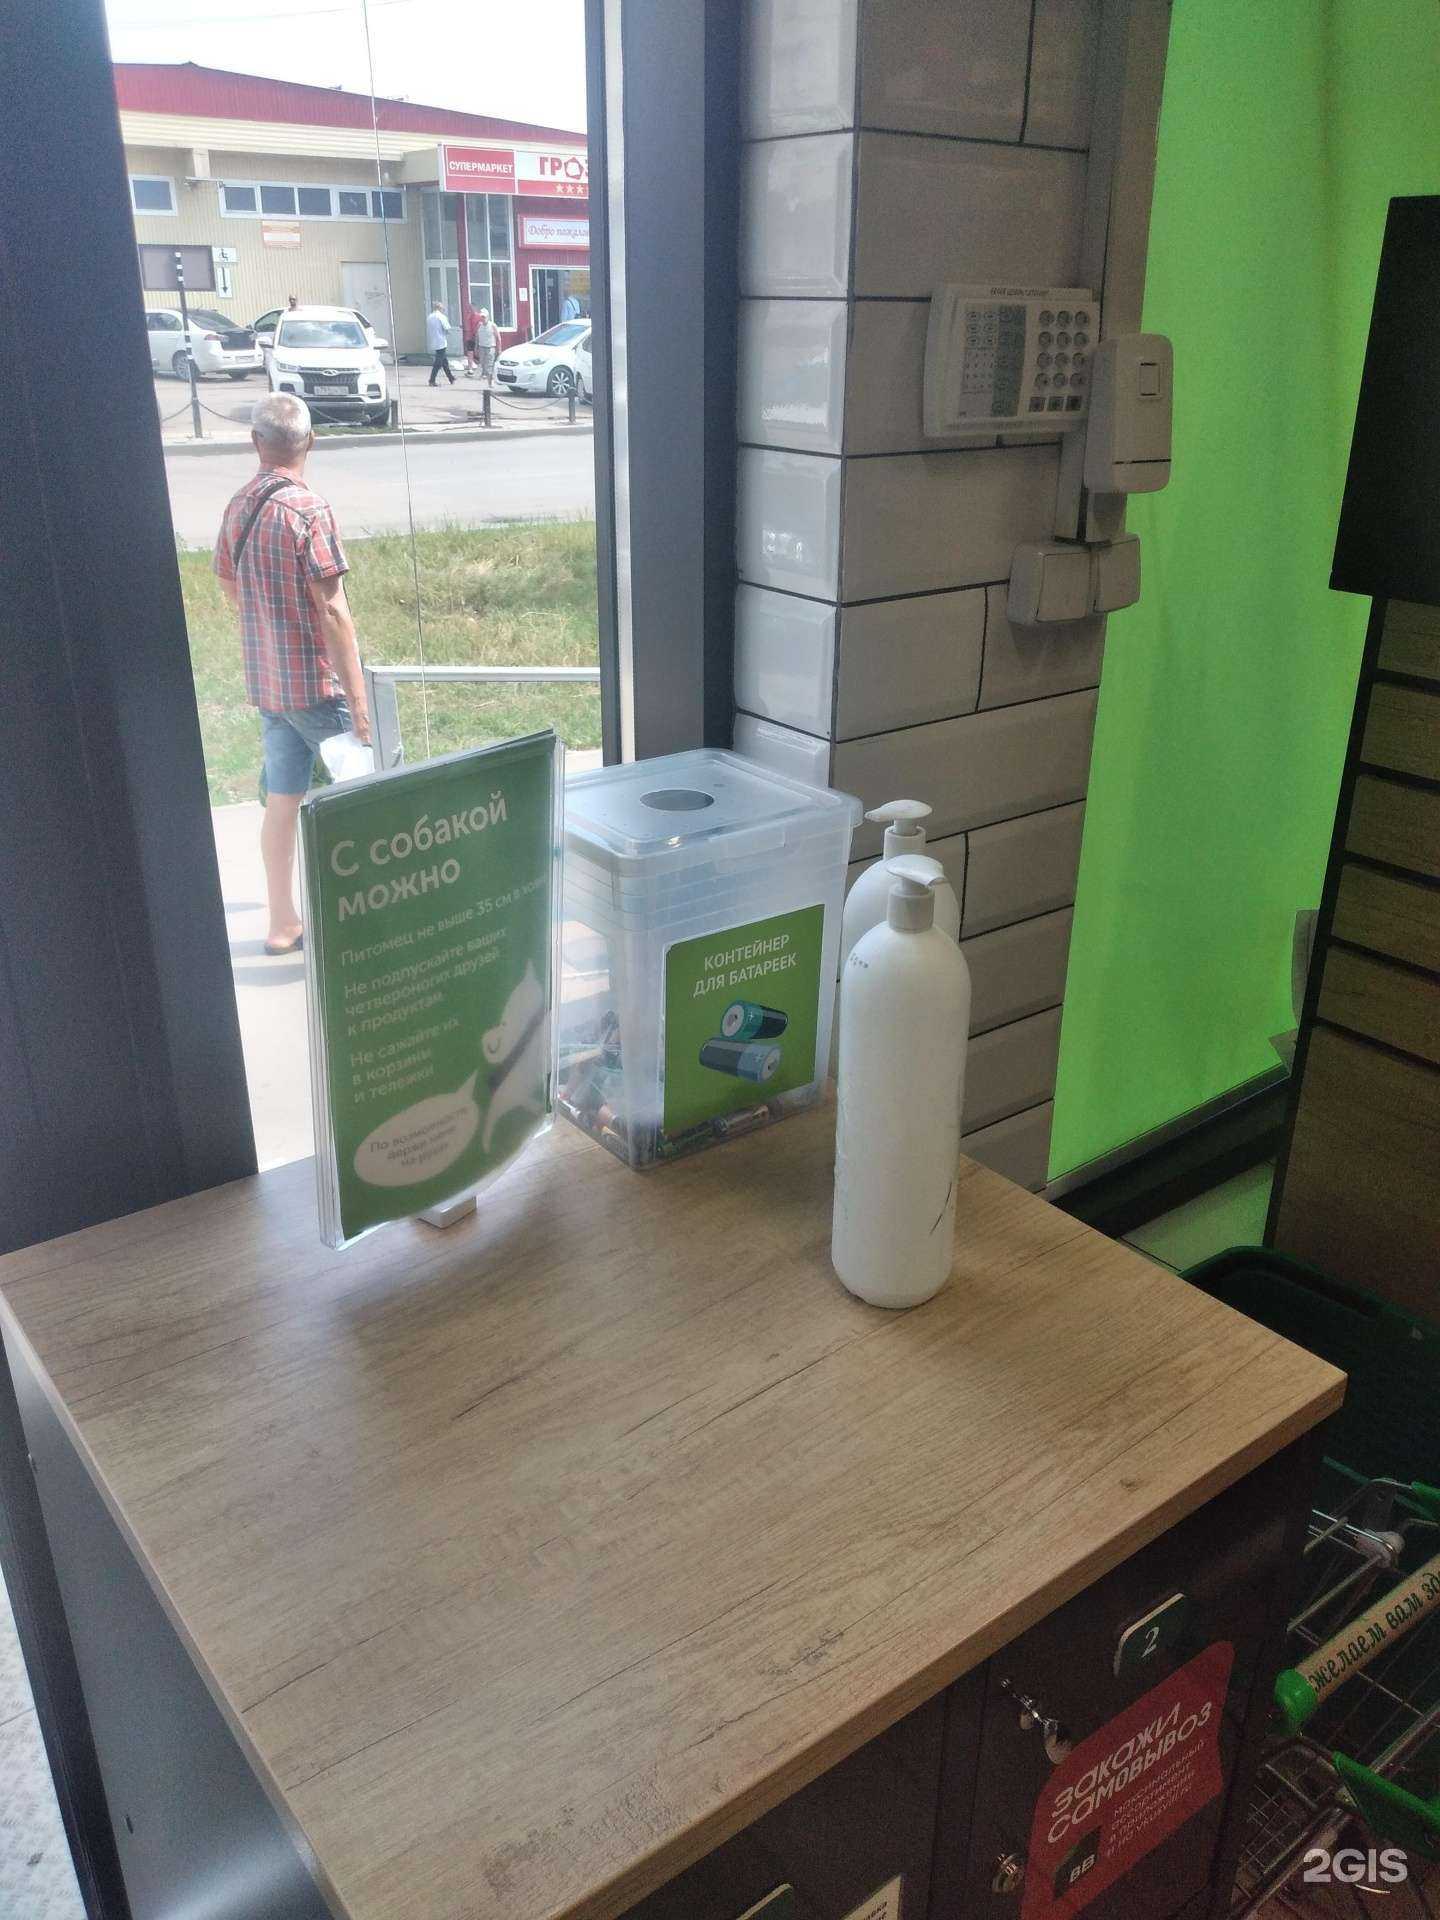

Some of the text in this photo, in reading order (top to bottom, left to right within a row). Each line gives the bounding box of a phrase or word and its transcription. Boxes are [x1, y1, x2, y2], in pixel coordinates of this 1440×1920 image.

[449, 160, 513, 174] СУПЕРМАРКЕТ
[539, 156, 588, 180] ГРО
[330, 790, 509, 877] С собакой
[338, 858, 461, 922] можно
[341, 931, 414, 968] Питомец
[417, 925, 435, 941] не
[438, 907, 474, 932] выше
[476, 898, 493, 916] 35
[495, 892, 512, 908] см
[344, 982, 367, 999] Не
[371, 944, 464, 990] подпускайте
[704, 934, 790, 971] КОНТЕЙНЕР
[693, 952, 798, 998] ДЛЯ БАТАРЕЕК
[351, 1049, 374, 1067] Не
[1385, 1592, 1424, 1630] вам
[1141, 1626, 1160, 1658] 2
